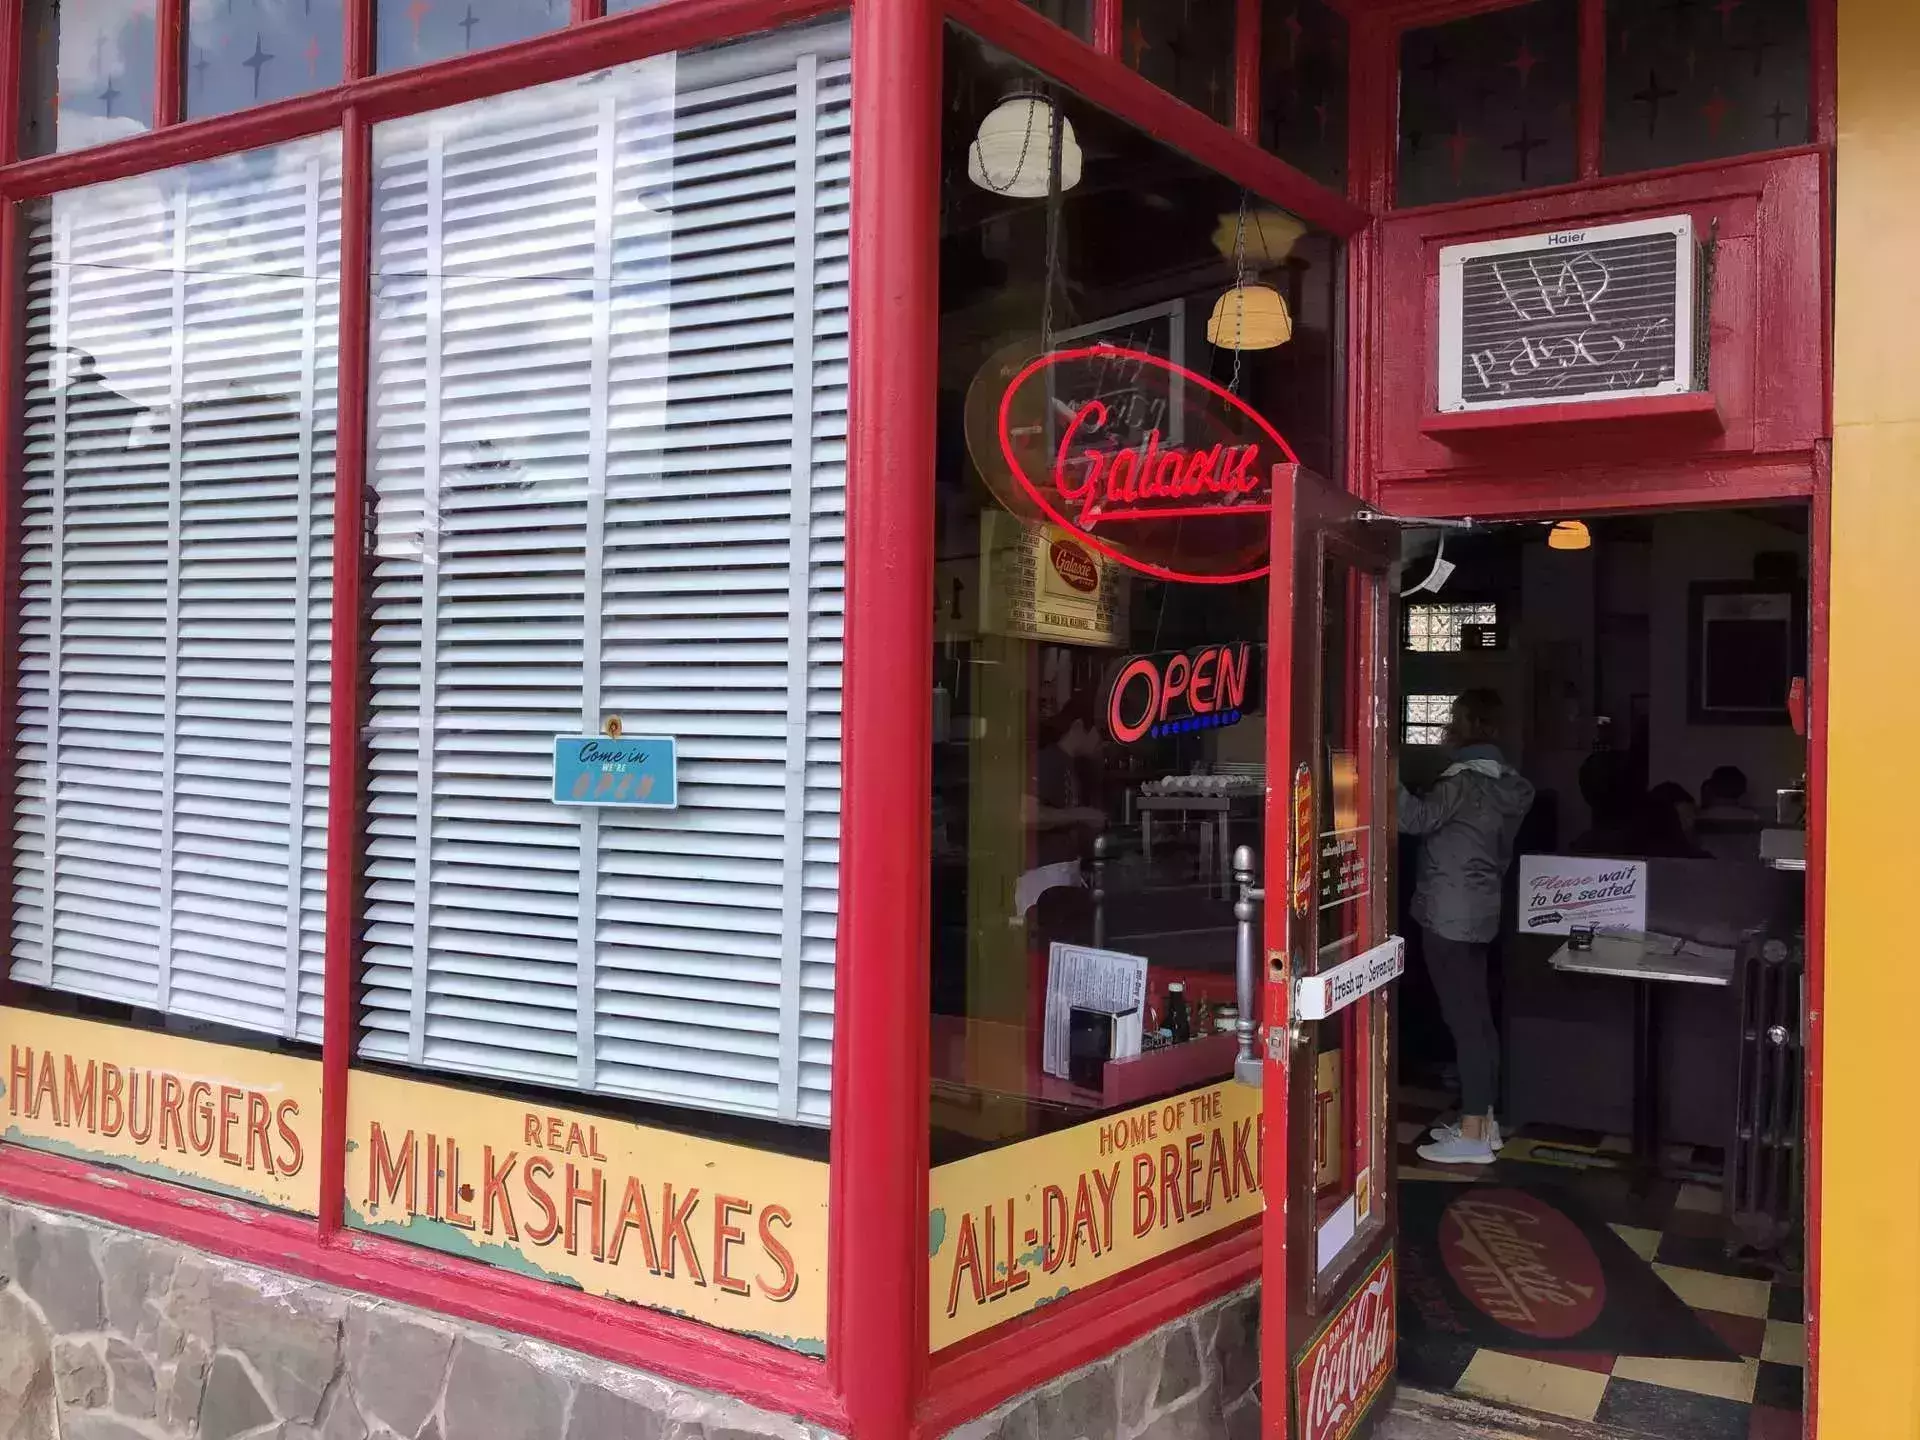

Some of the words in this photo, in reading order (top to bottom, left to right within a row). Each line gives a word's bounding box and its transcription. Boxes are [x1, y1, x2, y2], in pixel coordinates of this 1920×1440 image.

[1547, 231, 1586, 246] Haier
[1055, 401, 1260, 521] Galaxie
[1055, 549, 1092, 578] Galaxie
[1108, 641, 1250, 745] OPEN
[579, 741, 624, 763] Come
[627, 747, 650, 763] in
[1529, 873, 1594, 890] Please
[1598, 865, 1637, 882] wait
[1530, 891, 1547, 907] to
[1552, 888, 1573, 904] be
[1578, 879, 1637, 901] seated
[8, 1043, 304, 1177] HAMBURGERS
[1098, 1109, 1159, 1156] HOME
[1162, 1101, 1187, 1134] OF
[1190, 1090, 1223, 1124] THE
[523, 1113, 608, 1161] REAL
[369, 1121, 799, 1302] MILKSHAKES
[946, 1160, 1120, 1319] ALL-DAY
[1328, 1303, 1357, 1349] DRINK
[1353, 1390, 1368, 1418] Ice
[1368, 1361, 1388, 1392] Cold
